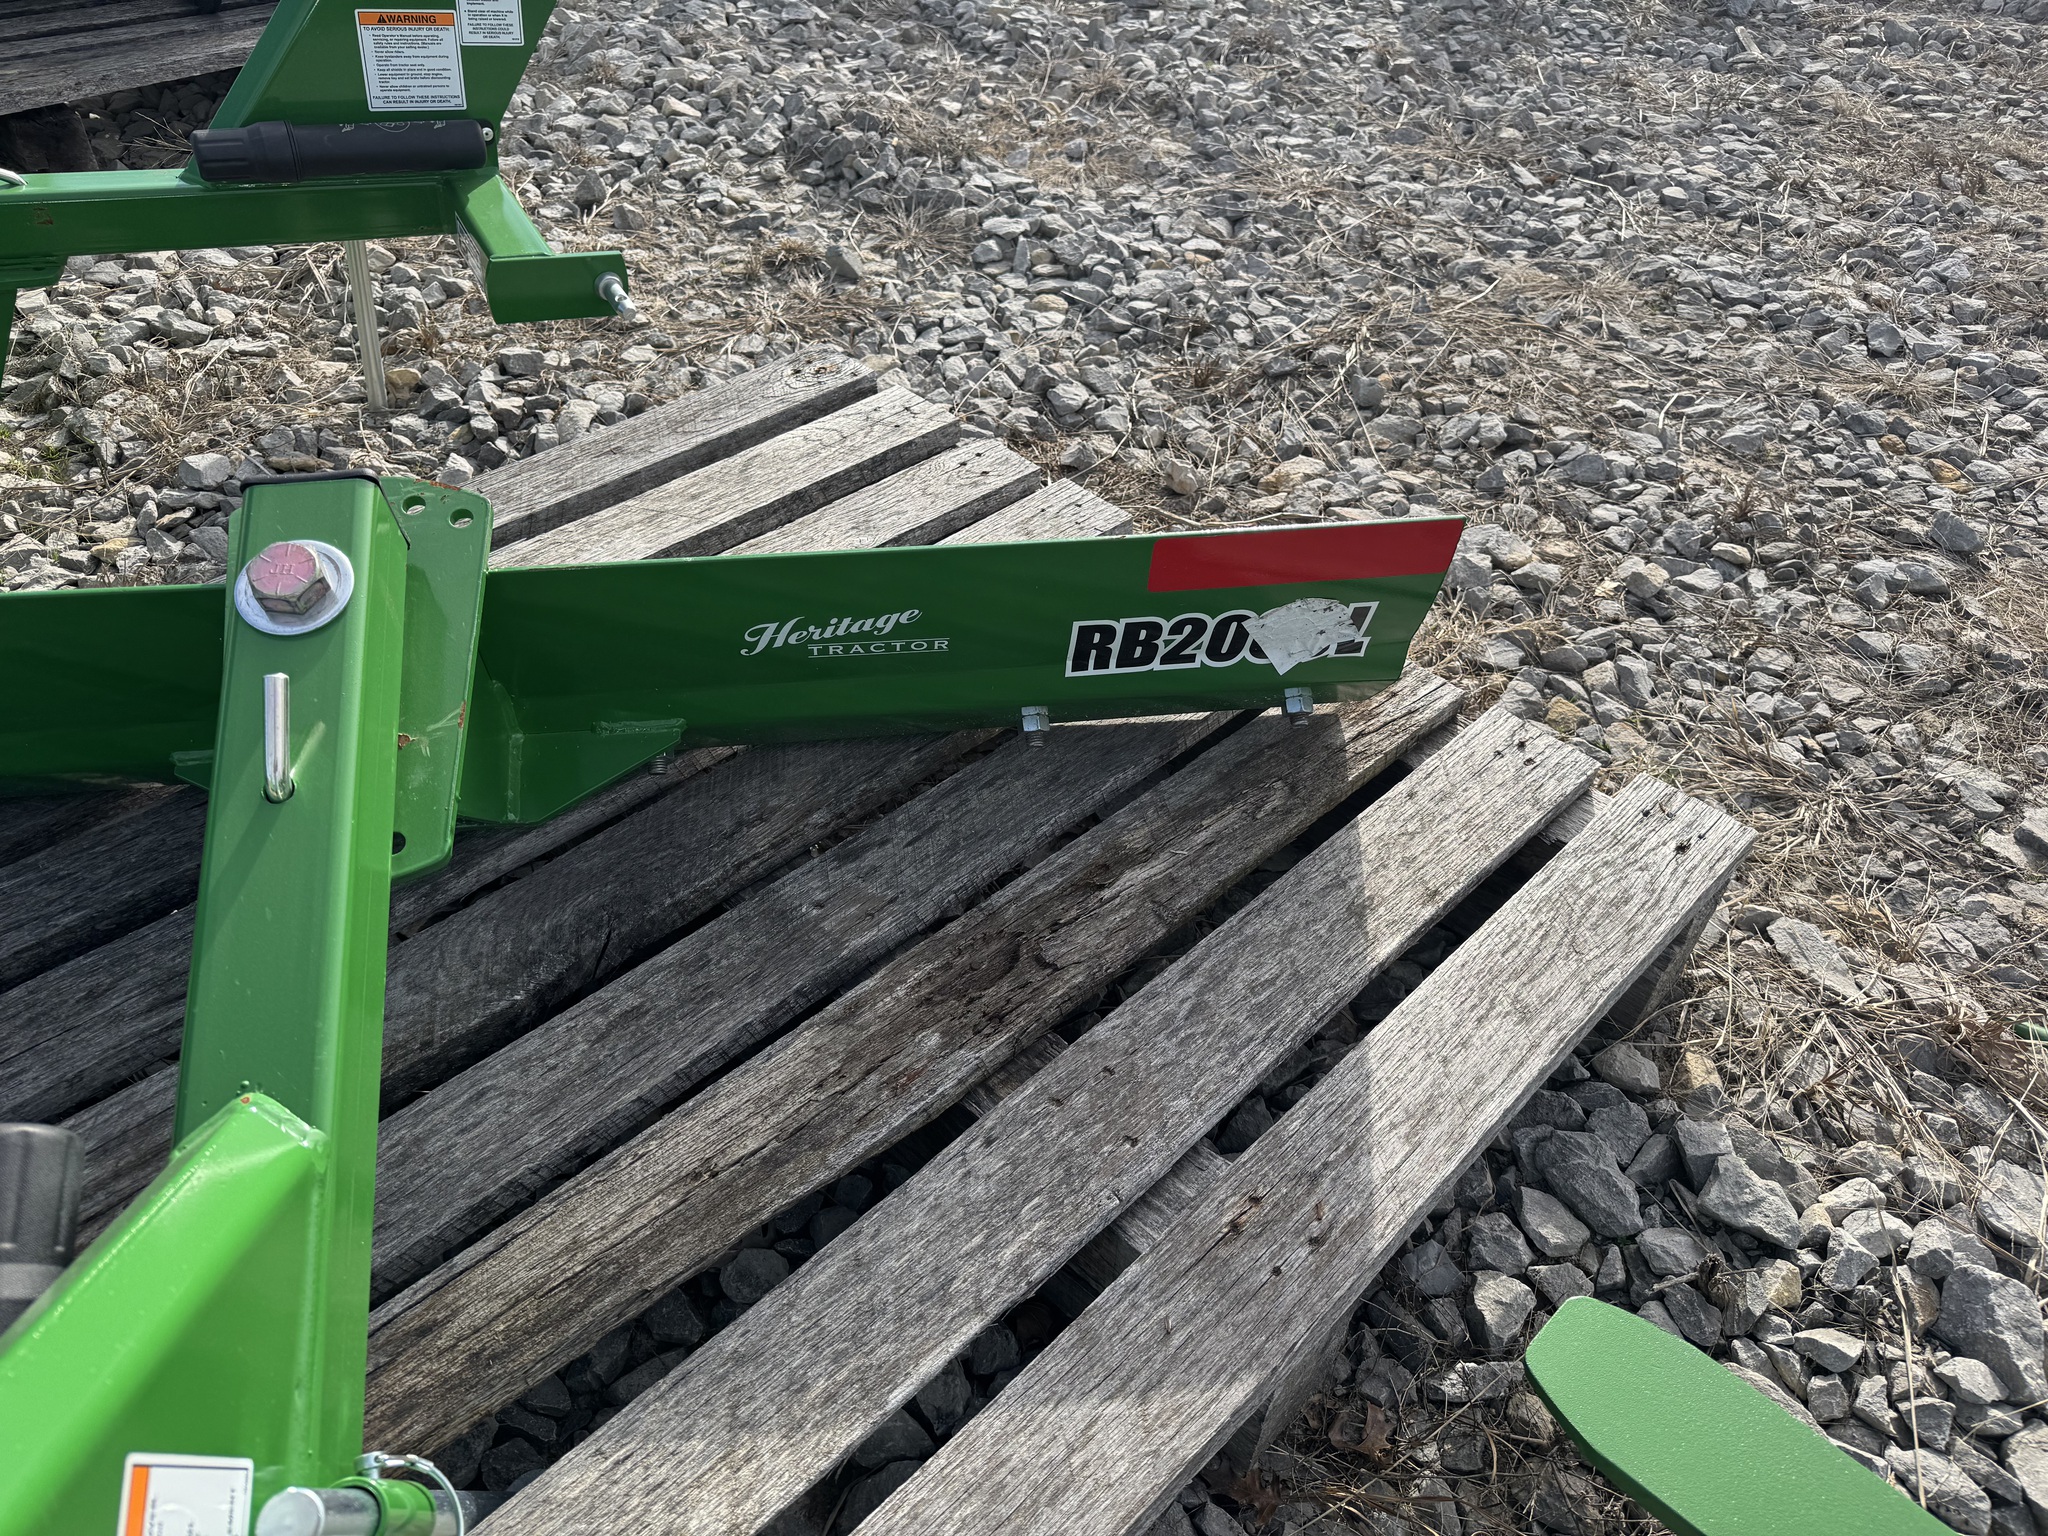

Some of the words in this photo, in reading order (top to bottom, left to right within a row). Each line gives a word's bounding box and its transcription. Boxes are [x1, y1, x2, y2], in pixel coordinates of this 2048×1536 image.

[386, 15, 436, 23] WARNING
[269, 564, 295, 575] JH
[741, 609, 922, 656] Heritage
[808, 641, 949, 656] TRACTOR
